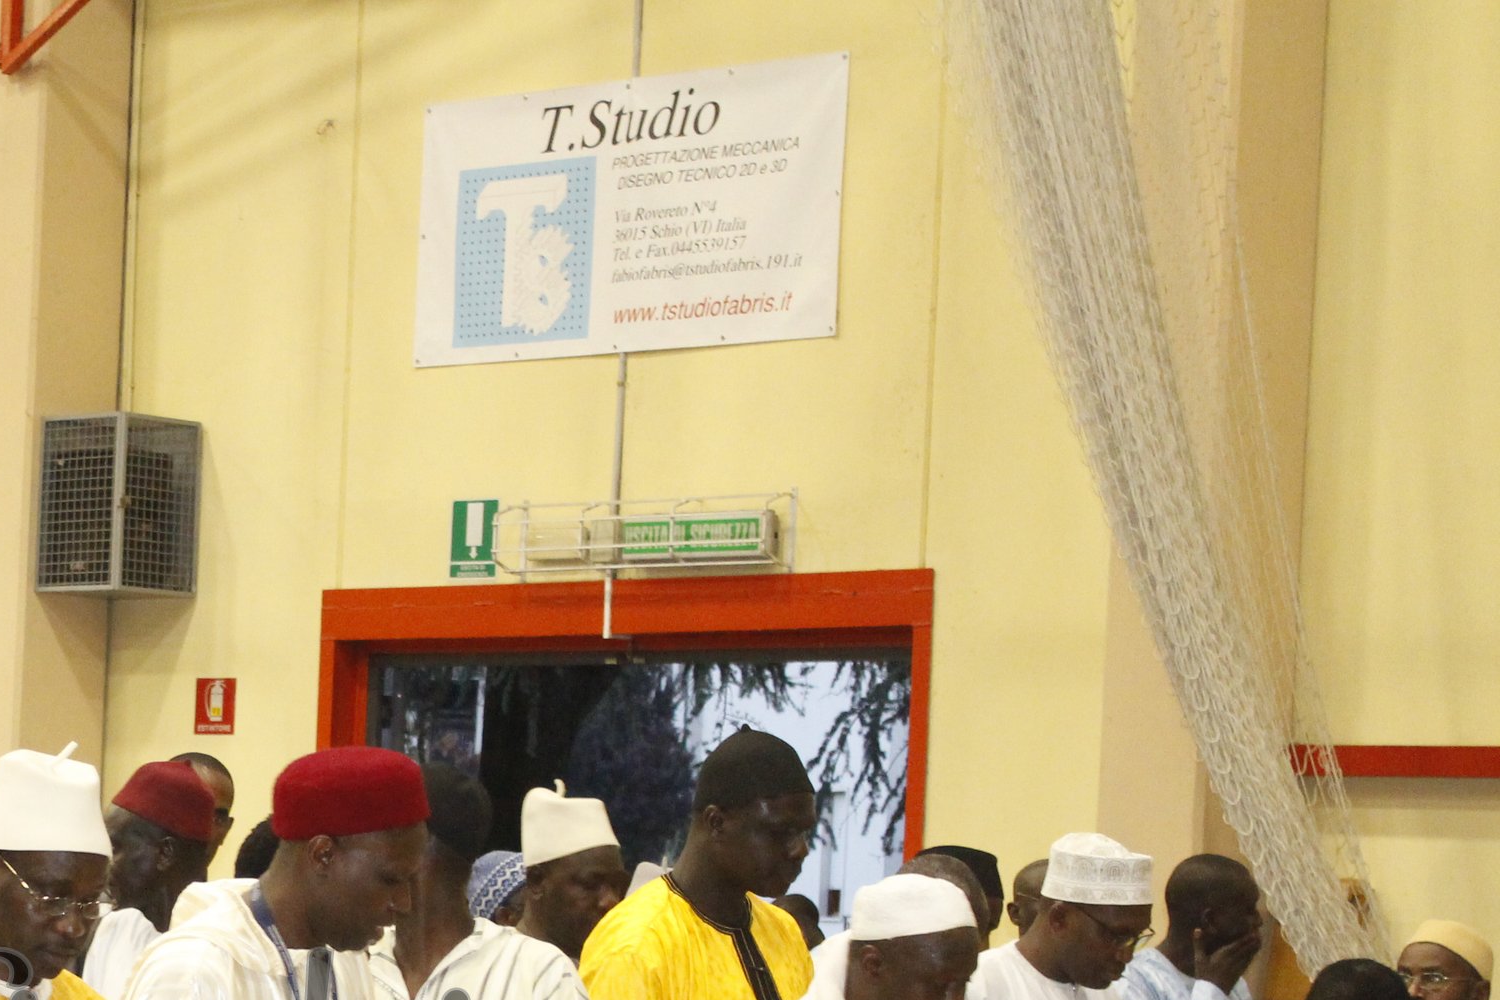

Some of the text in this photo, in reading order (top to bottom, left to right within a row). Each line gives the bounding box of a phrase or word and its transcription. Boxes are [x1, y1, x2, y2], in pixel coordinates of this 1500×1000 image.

[541, 88, 721, 154] T.Studio
[612, 137, 799, 170] PROGETTAZIONE MECCANICA
[617, 171, 674, 190] DISEGNO
[677, 164, 736, 183] TECNICO
[739, 162, 757, 177] 2D
[770, 159, 788, 173] 3D
[615, 209, 631, 223] Via
[634, 206, 688, 222] Rovereto
[650, 223, 682, 240] Schio
[685, 219, 713, 237] (VI)
[715, 217, 747, 232] Italia
[613, 291, 793, 324] www.tstudiofabris.it
